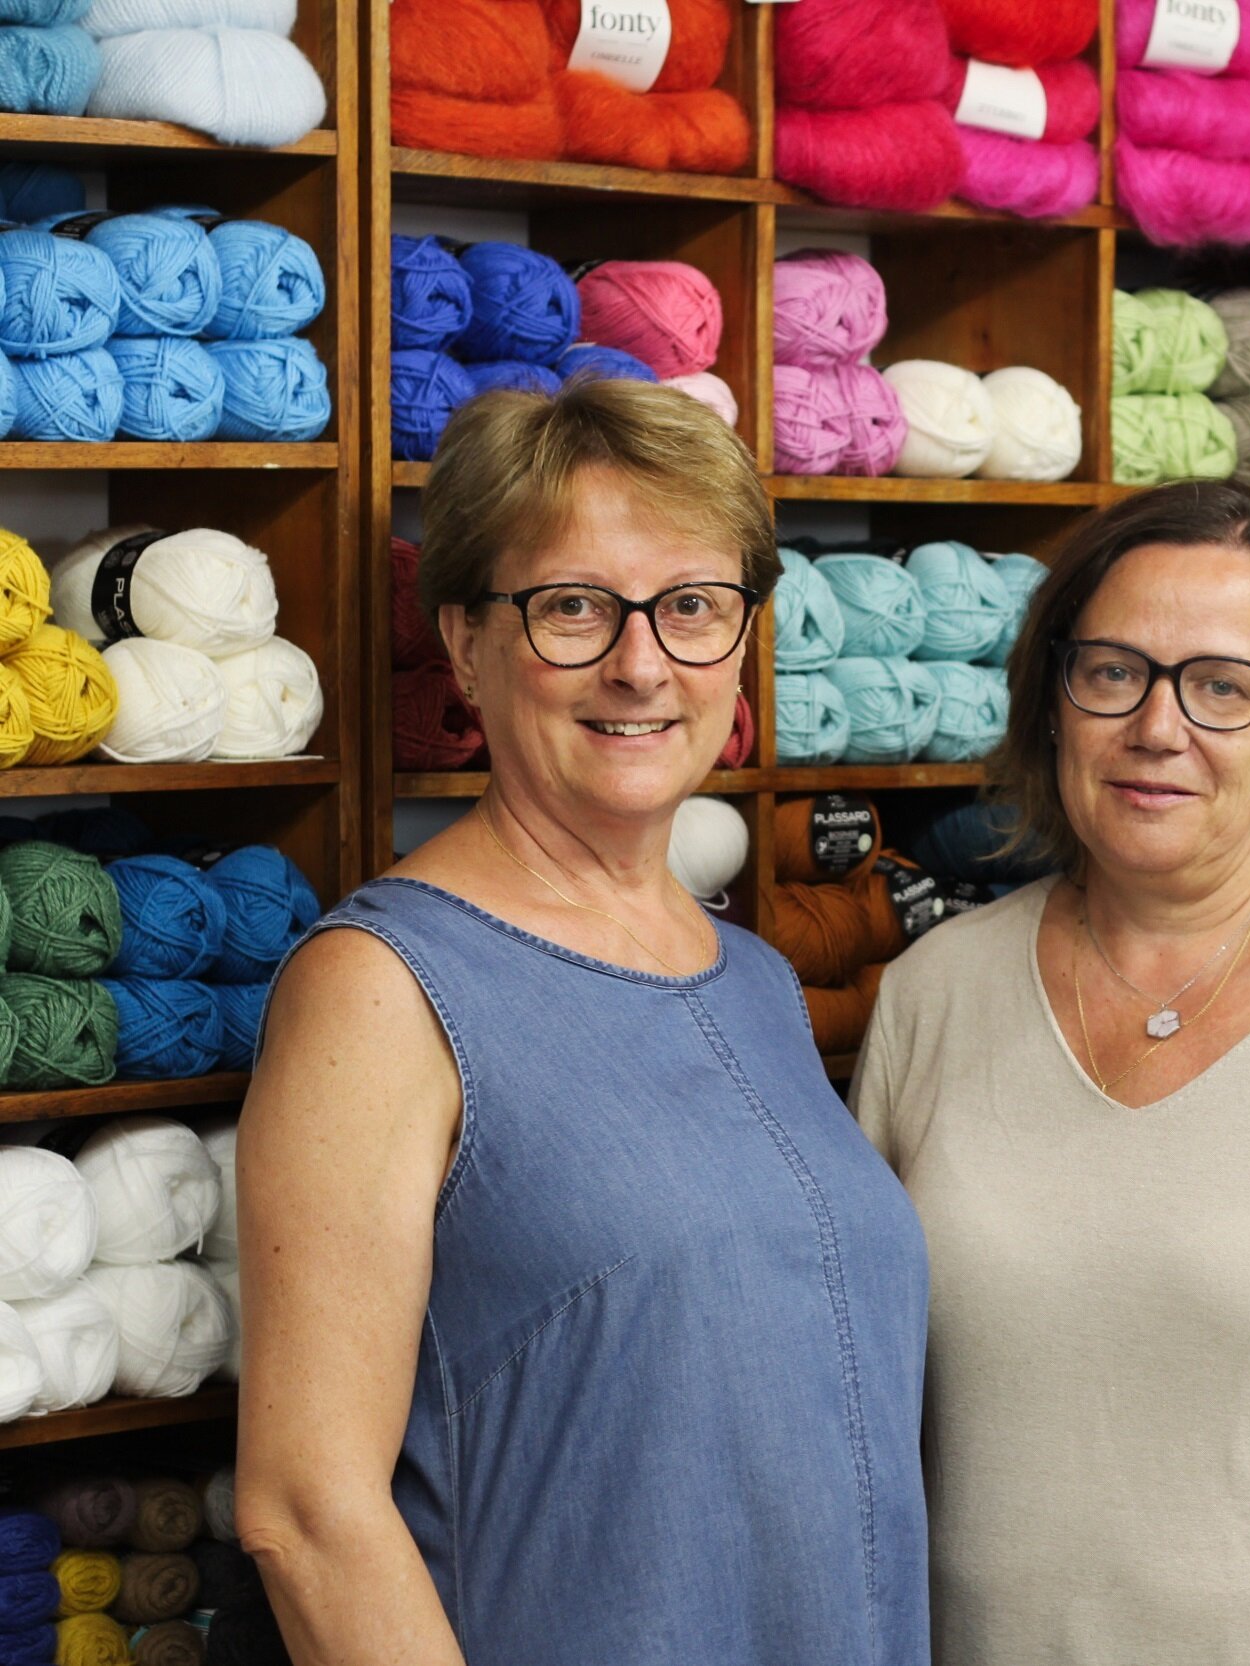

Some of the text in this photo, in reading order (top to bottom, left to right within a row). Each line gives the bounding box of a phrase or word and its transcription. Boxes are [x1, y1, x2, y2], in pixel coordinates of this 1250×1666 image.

[589, 4, 661, 42] fonty
[113, 577, 134, 633] PLAS
[814, 810, 871, 824] PLASSARD
[893, 877, 936, 903] PLASSARD
